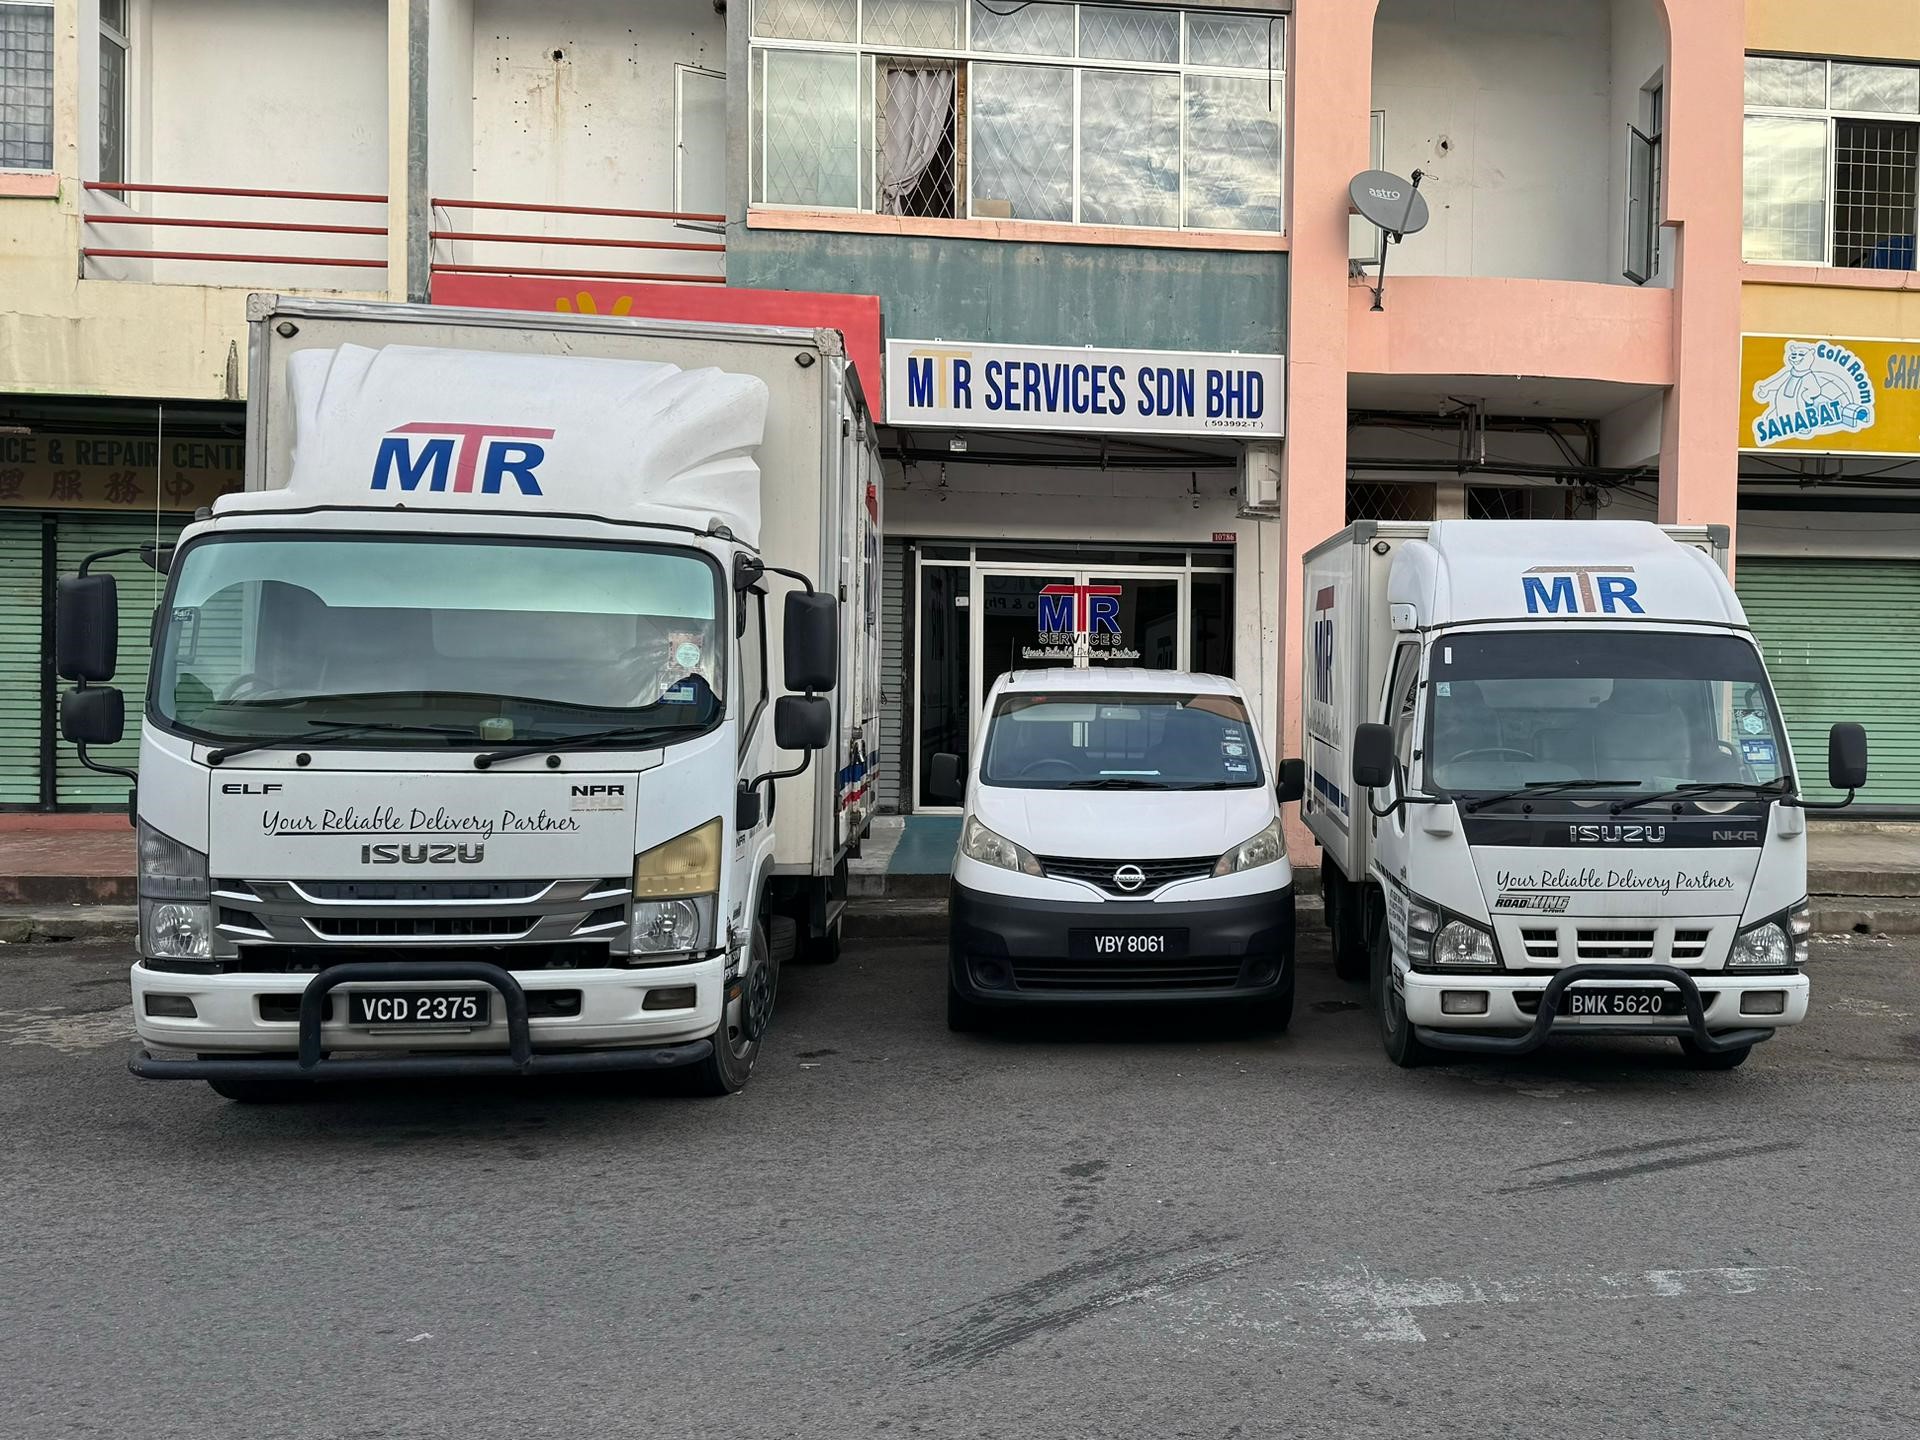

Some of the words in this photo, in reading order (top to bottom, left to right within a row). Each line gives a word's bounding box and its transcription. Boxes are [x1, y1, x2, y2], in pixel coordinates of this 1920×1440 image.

[1368, 187, 1400, 200] astro
[908, 349, 972, 409] MTR
[985, 360, 1126, 415] SERVICES
[1138, 366, 1195, 417] SDN
[1206, 369, 1264, 418] BHD
[1816, 344, 1851, 367] Cold
[1847, 361, 1872, 404] Room
[1756, 400, 1842, 442] SAHABAT
[48, 438, 64, 465] &
[76, 439, 158, 468] REPAIR
[370, 422, 556, 496] MTR
[1521, 565, 1646, 614] MTR
[1038, 584, 1123, 633] MTR
[1038, 632, 1122, 646] SERVICES
[222, 783, 283, 795] ELF
[571, 784, 625, 797] NPR
[262, 809, 318, 837] Your
[322, 806, 404, 832] Reliable
[409, 806, 495, 840] Delivery
[501, 809, 581, 832] Partner
[1569, 825, 1666, 842] ISUZU
[1712, 830, 1758, 841] NKR
[360, 842, 485, 865] ISUZU
[1496, 870, 1538, 892] Your
[1541, 868, 1604, 888] Reliable
[1607, 869, 1671, 896] Delivery
[1675, 870, 1735, 889] Partner
[1094, 935, 1125, 953] VBY
[1127, 935, 1165, 953] 8061
[362, 998, 408, 1021] VCD
[416, 996, 477, 1020] 2375
[1572, 995, 1608, 1014] BMK
[1613, 995, 1662, 1014] 5620
